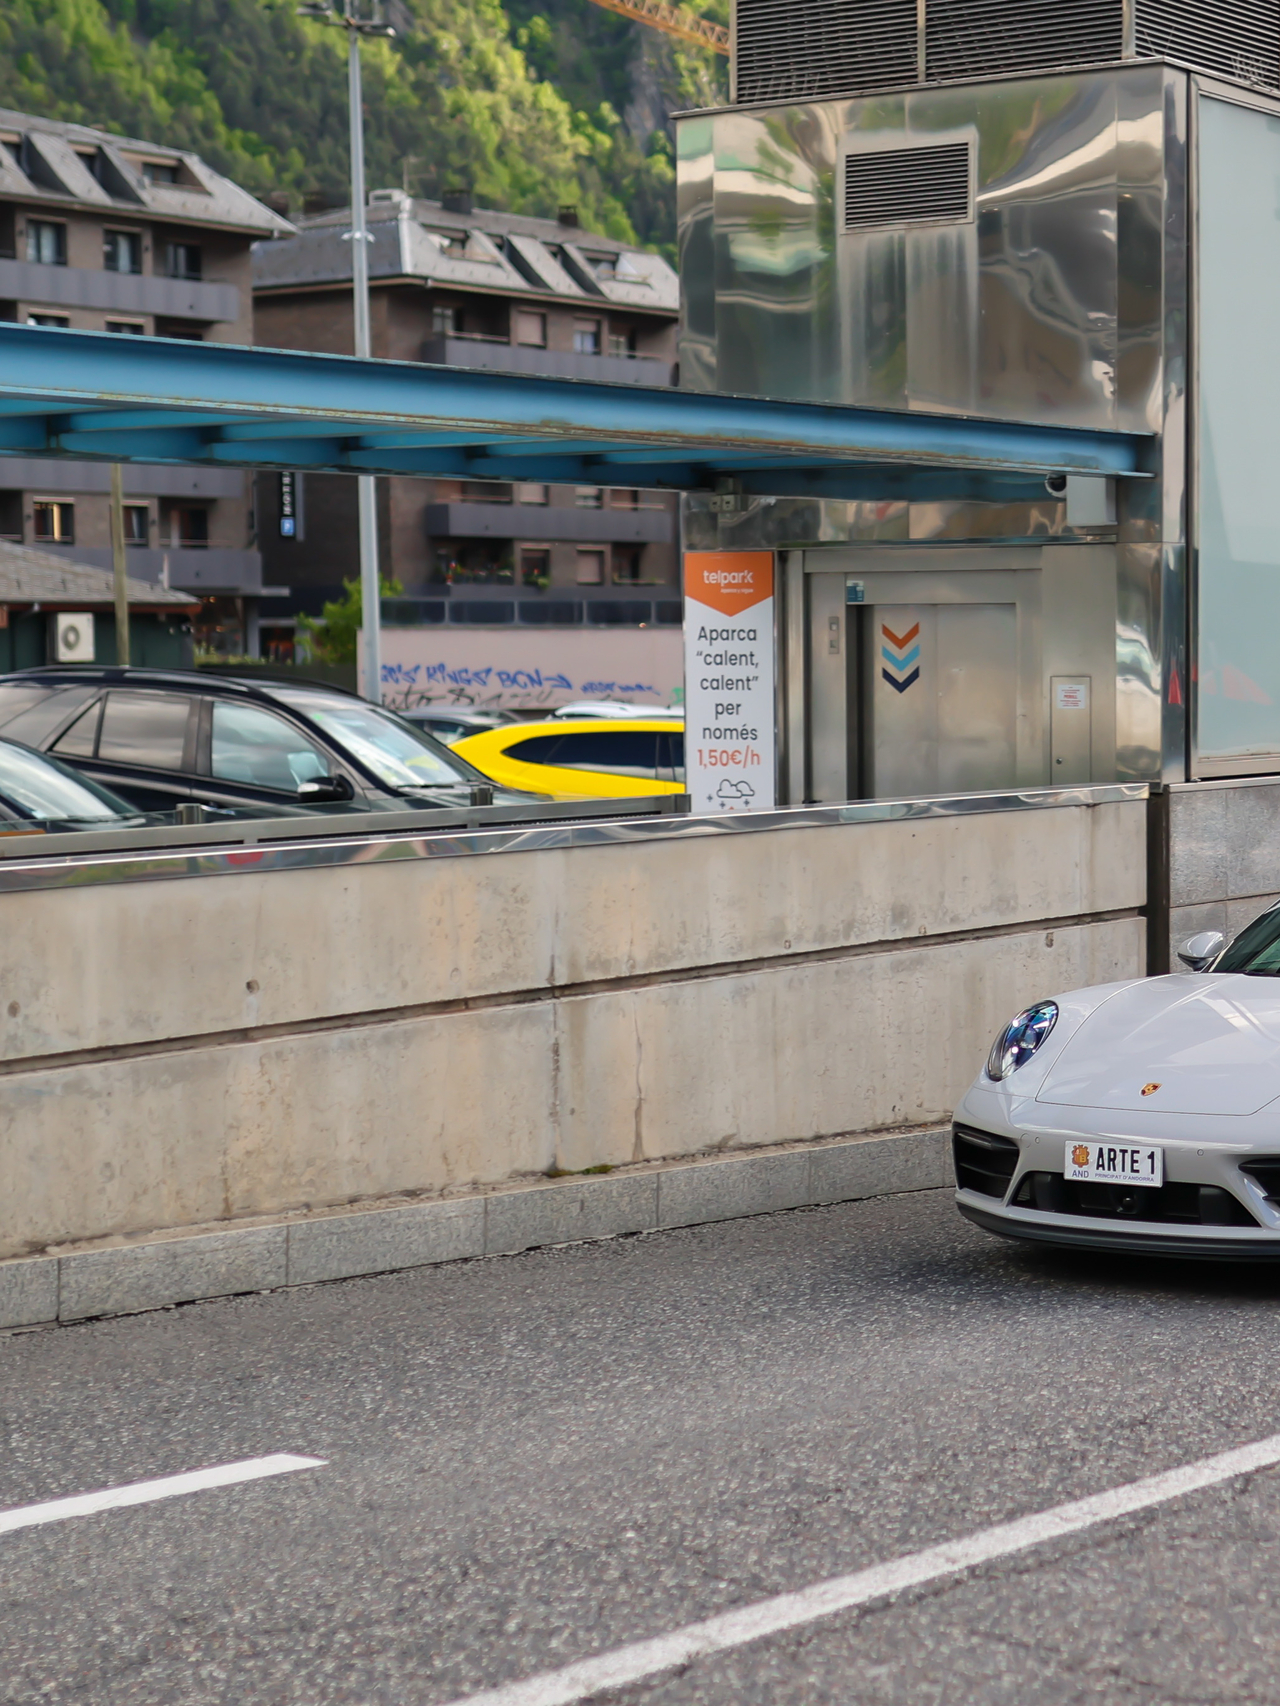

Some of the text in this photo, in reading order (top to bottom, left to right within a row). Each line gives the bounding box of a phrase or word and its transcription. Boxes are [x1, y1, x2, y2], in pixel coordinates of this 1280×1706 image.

[703, 570, 754, 587] telpark
[697, 626, 757, 646] Aparca
[715, 703, 741, 720] per
[702, 723, 758, 741] només
[697, 744, 761, 769] 1,50€/h
[1096, 1147, 1155, 1175] ARTE 1
[1072, 1170, 1089, 1178] AND
[1095, 1172, 1122, 1180] PRINCIPAT
